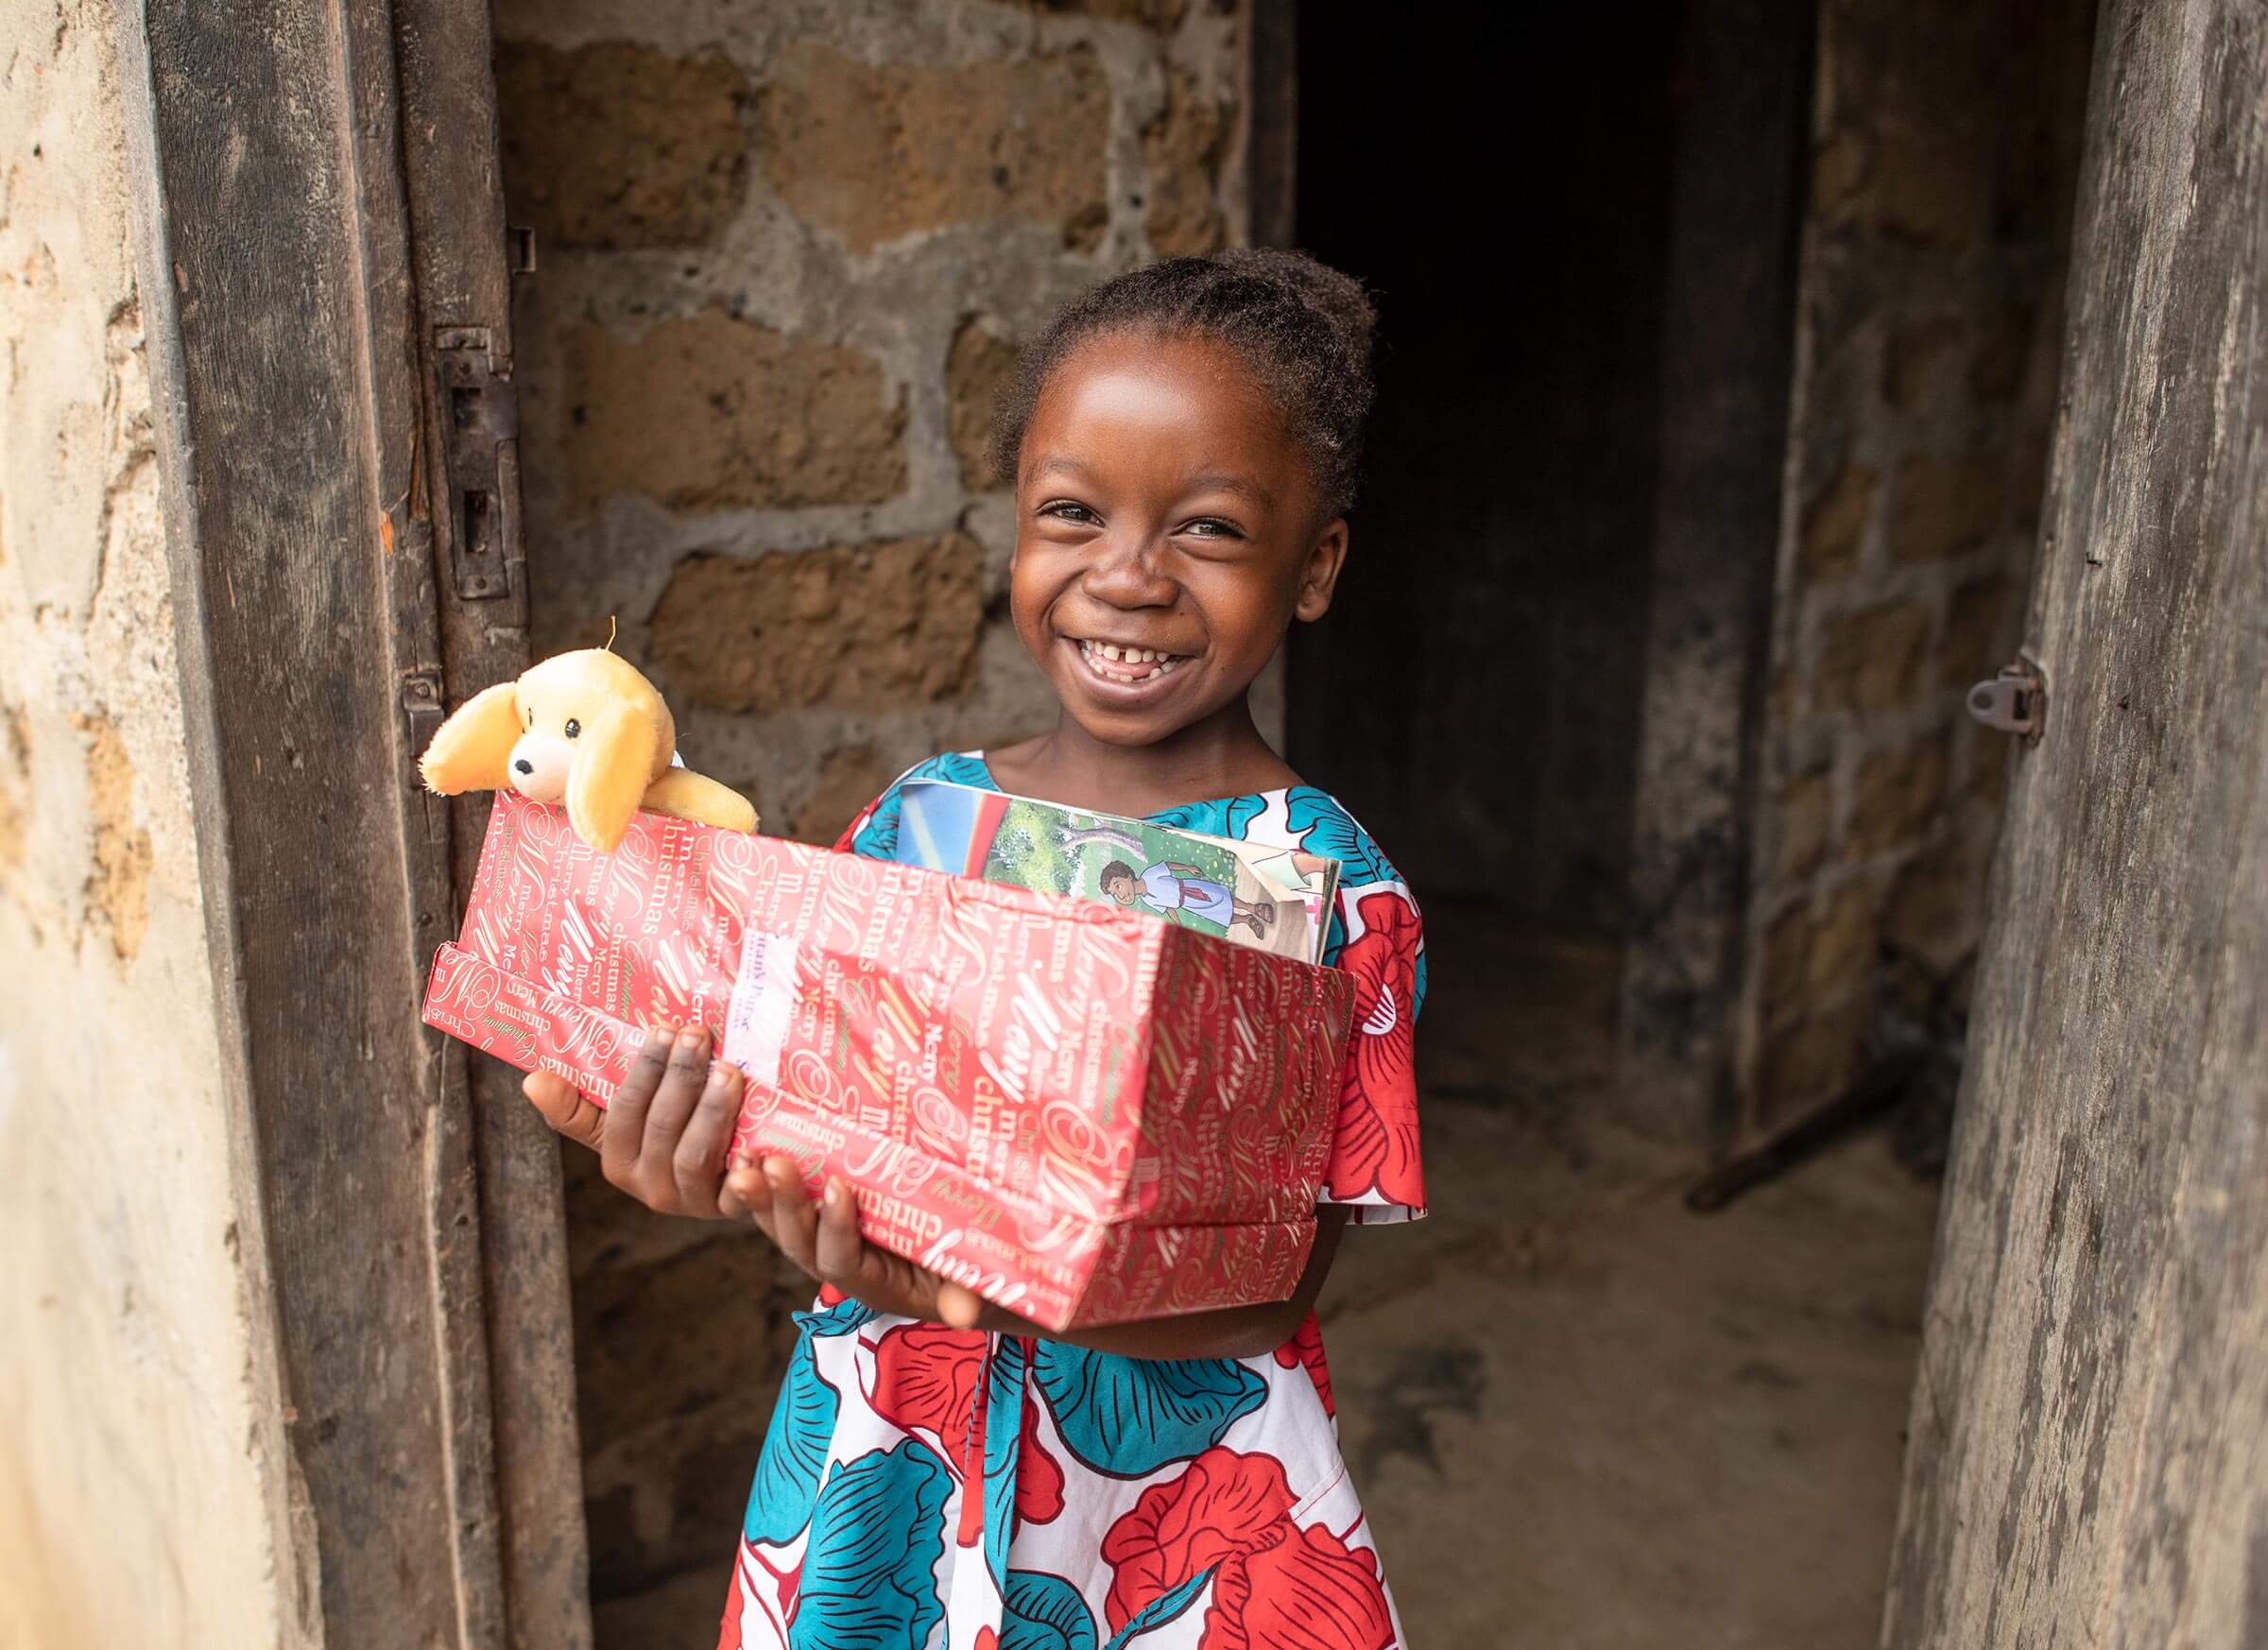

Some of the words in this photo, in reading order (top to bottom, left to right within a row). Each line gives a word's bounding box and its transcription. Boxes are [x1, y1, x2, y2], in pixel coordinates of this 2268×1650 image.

[483, 812, 506, 888] merry
[493, 801, 559, 939] Merry
[667, 835, 696, 920] merry
[511, 884, 532, 936] merry
[685, 828, 762, 976] Merry
[886, 869, 925, 957] merry
[541, 888, 594, 998] Merry
[587, 946, 606, 999] Merry
[605, 922, 628, 1011] christmas
[709, 917, 730, 969] merry
[494, 1000, 552, 1037] christmas
[503, 980, 540, 1008] Merry
[688, 981, 713, 1025] Merr
[797, 986, 820, 1041] Merry
[819, 960, 844, 1057] christmas
[978, 958, 1060, 1105] Merry
[853, 964, 922, 1103] Merry
[915, 1023, 943, 1084] Merry
[538, 1055, 620, 1112] hristmas
